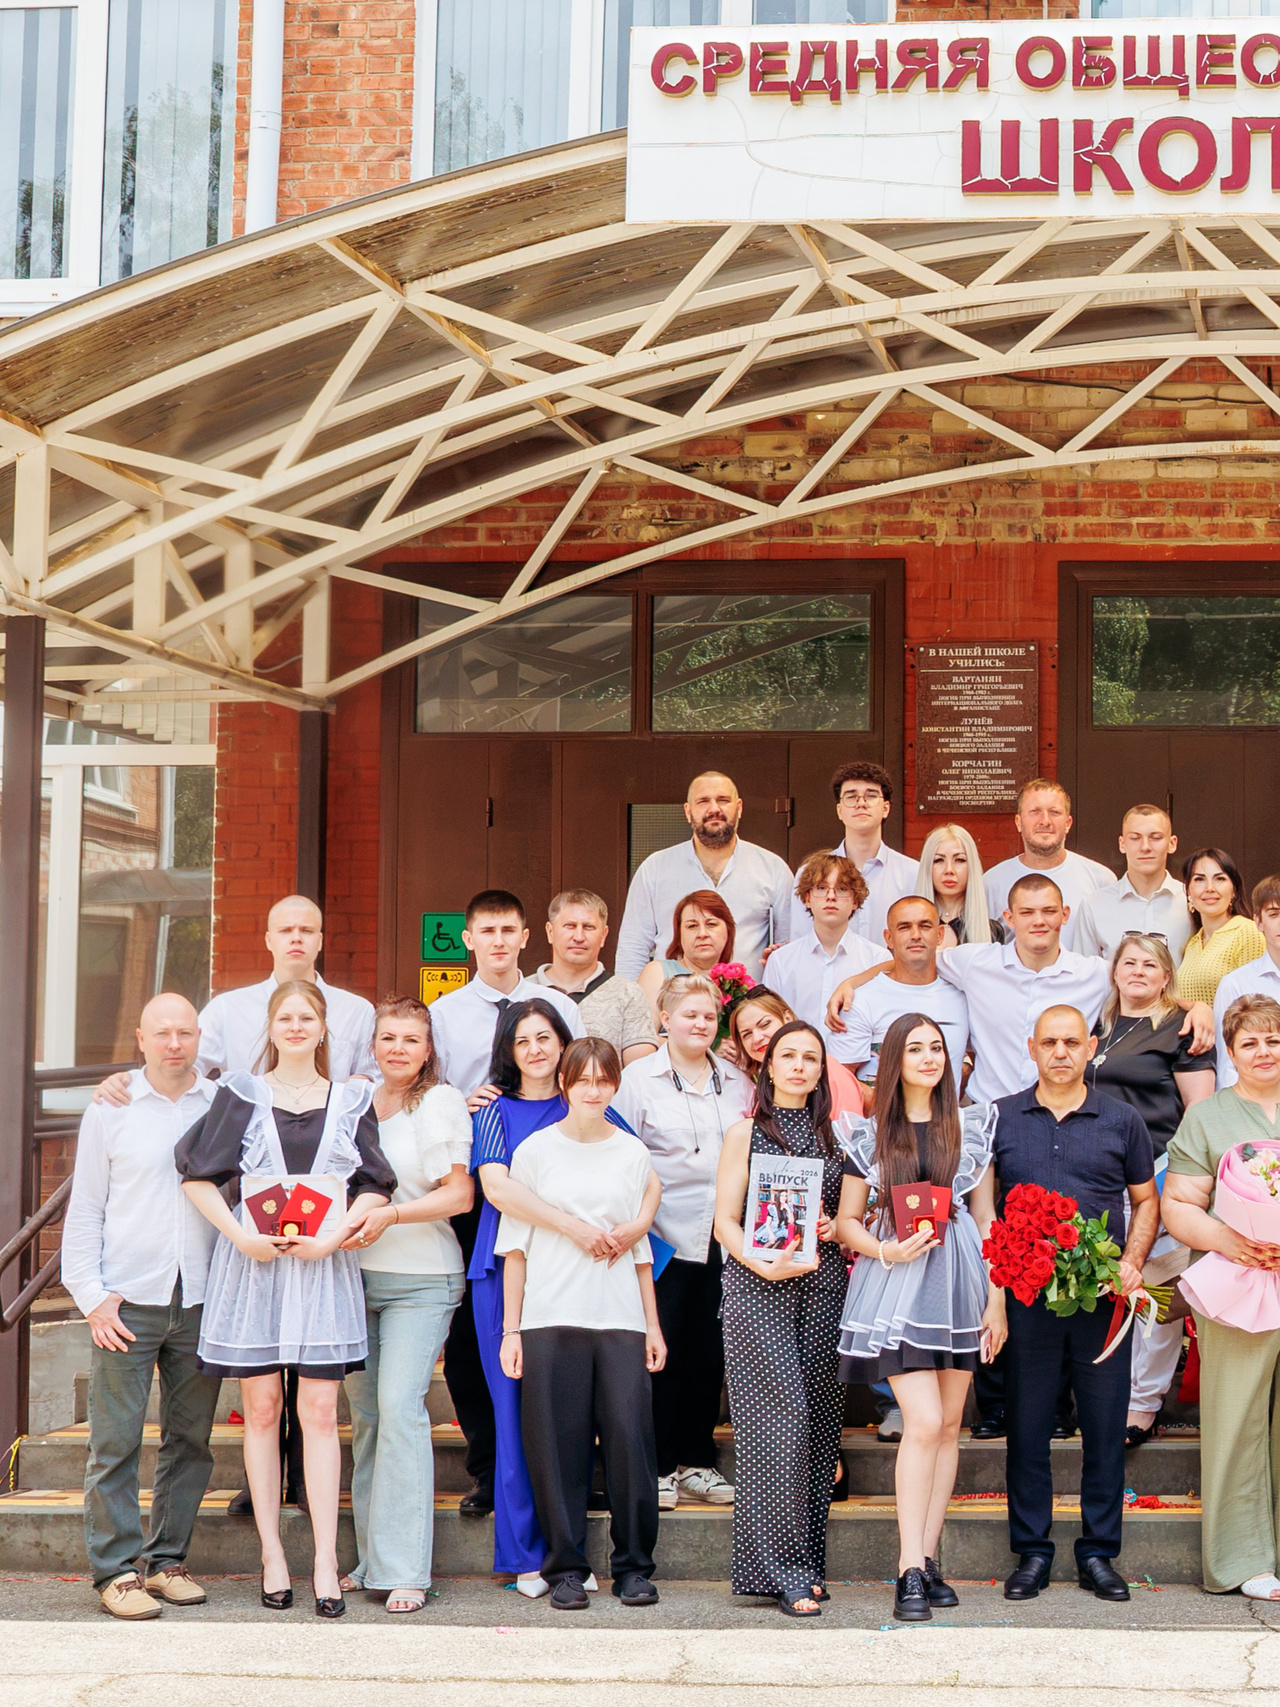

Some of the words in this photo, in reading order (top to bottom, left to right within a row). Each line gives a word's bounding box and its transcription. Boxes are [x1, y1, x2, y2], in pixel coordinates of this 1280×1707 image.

[650, 37, 990, 106] СРЕДНЯЯ
[939, 646, 981, 656] НАШЕЙ
[985, 647, 1026, 656] ШКОЛЕ
[949, 659, 1005, 668] УЧИЛИСЬ:
[961, 716, 993, 725] ЛУНЁВ
[801, 1169, 819, 1177] 2026
[758, 1172, 808, 1186] ВЫПУСК
